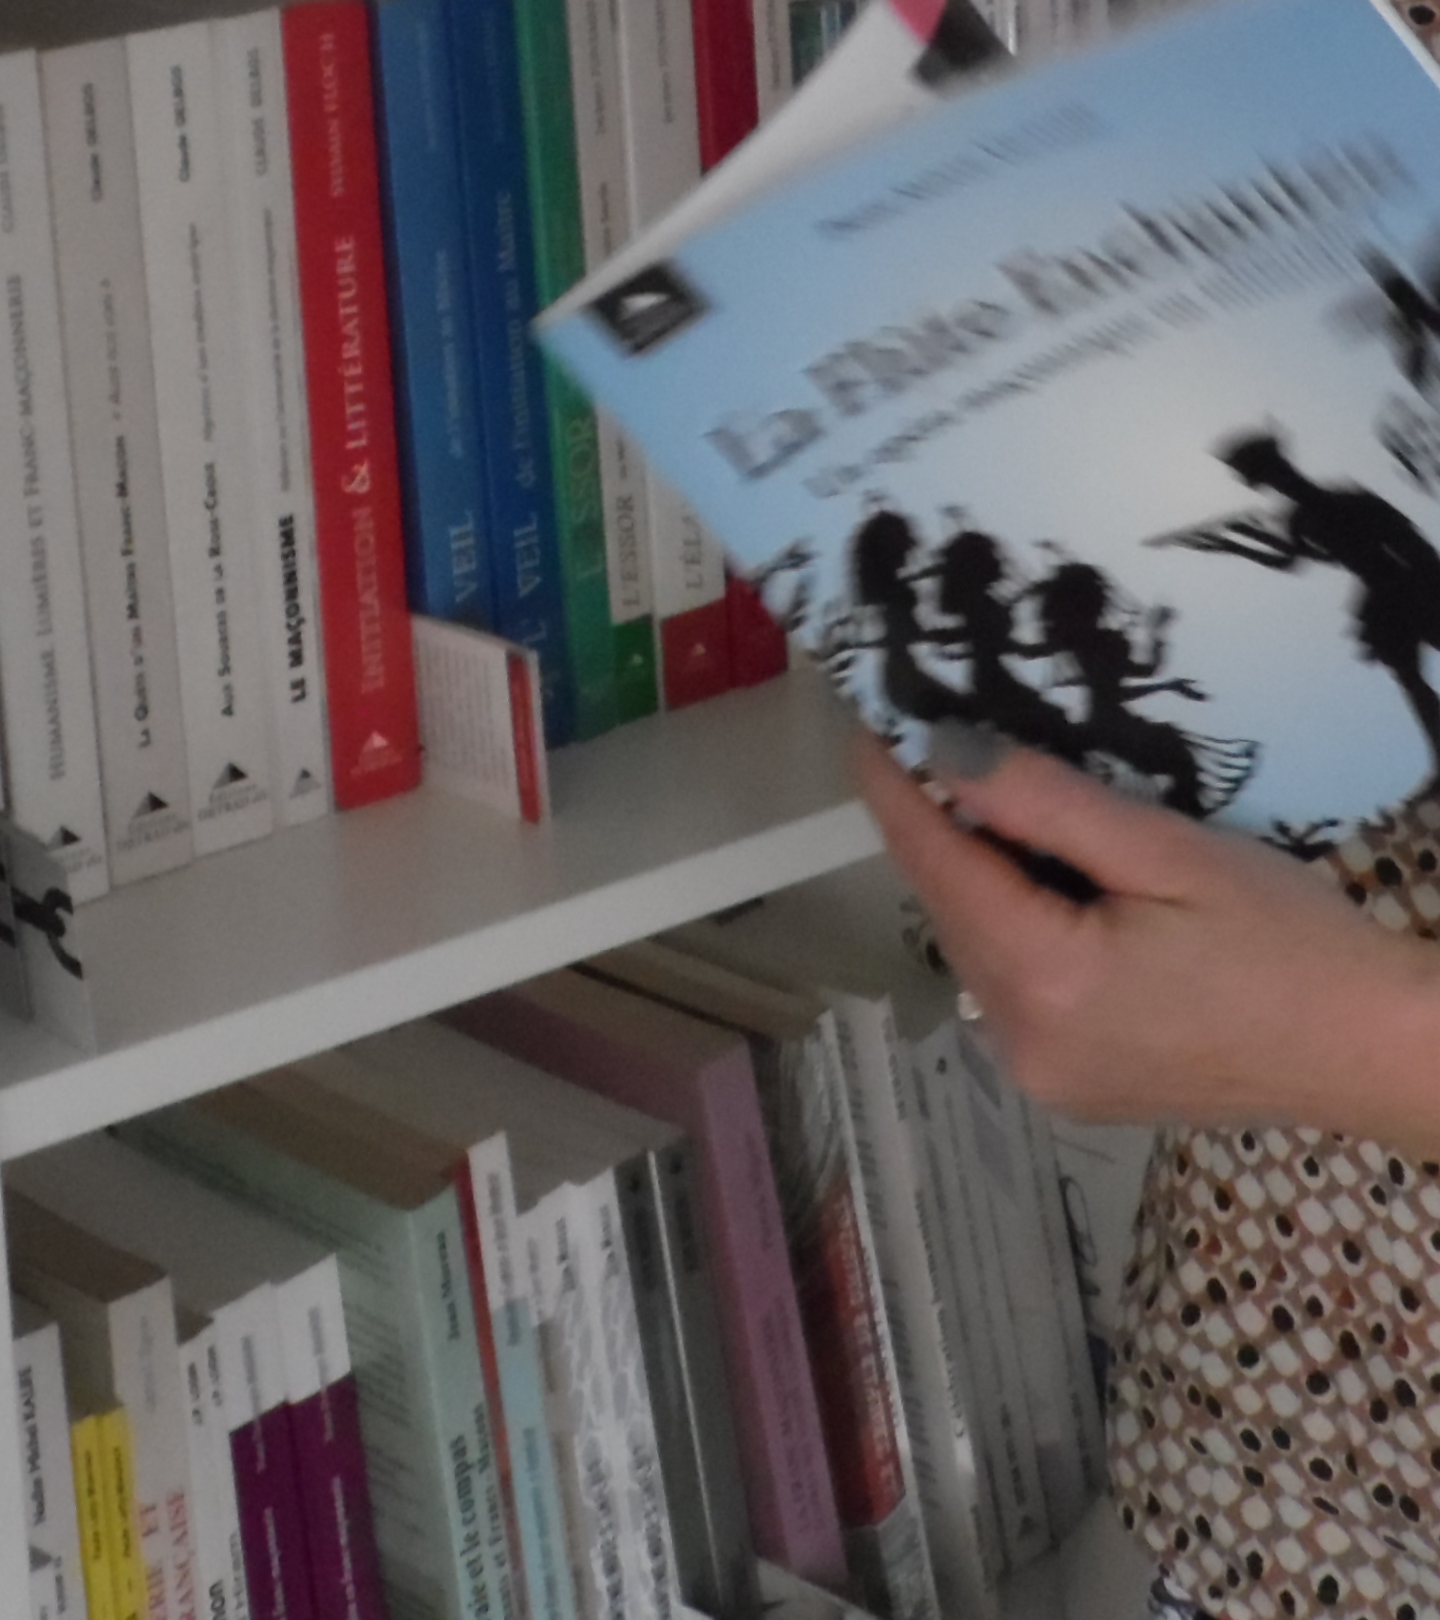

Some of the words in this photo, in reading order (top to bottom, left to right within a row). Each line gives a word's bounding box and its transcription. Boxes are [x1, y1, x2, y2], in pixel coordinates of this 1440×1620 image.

[331, 234, 370, 450] LITTÉRATURE
[341, 462, 372, 495] &
[289, 679, 309, 703] LE
